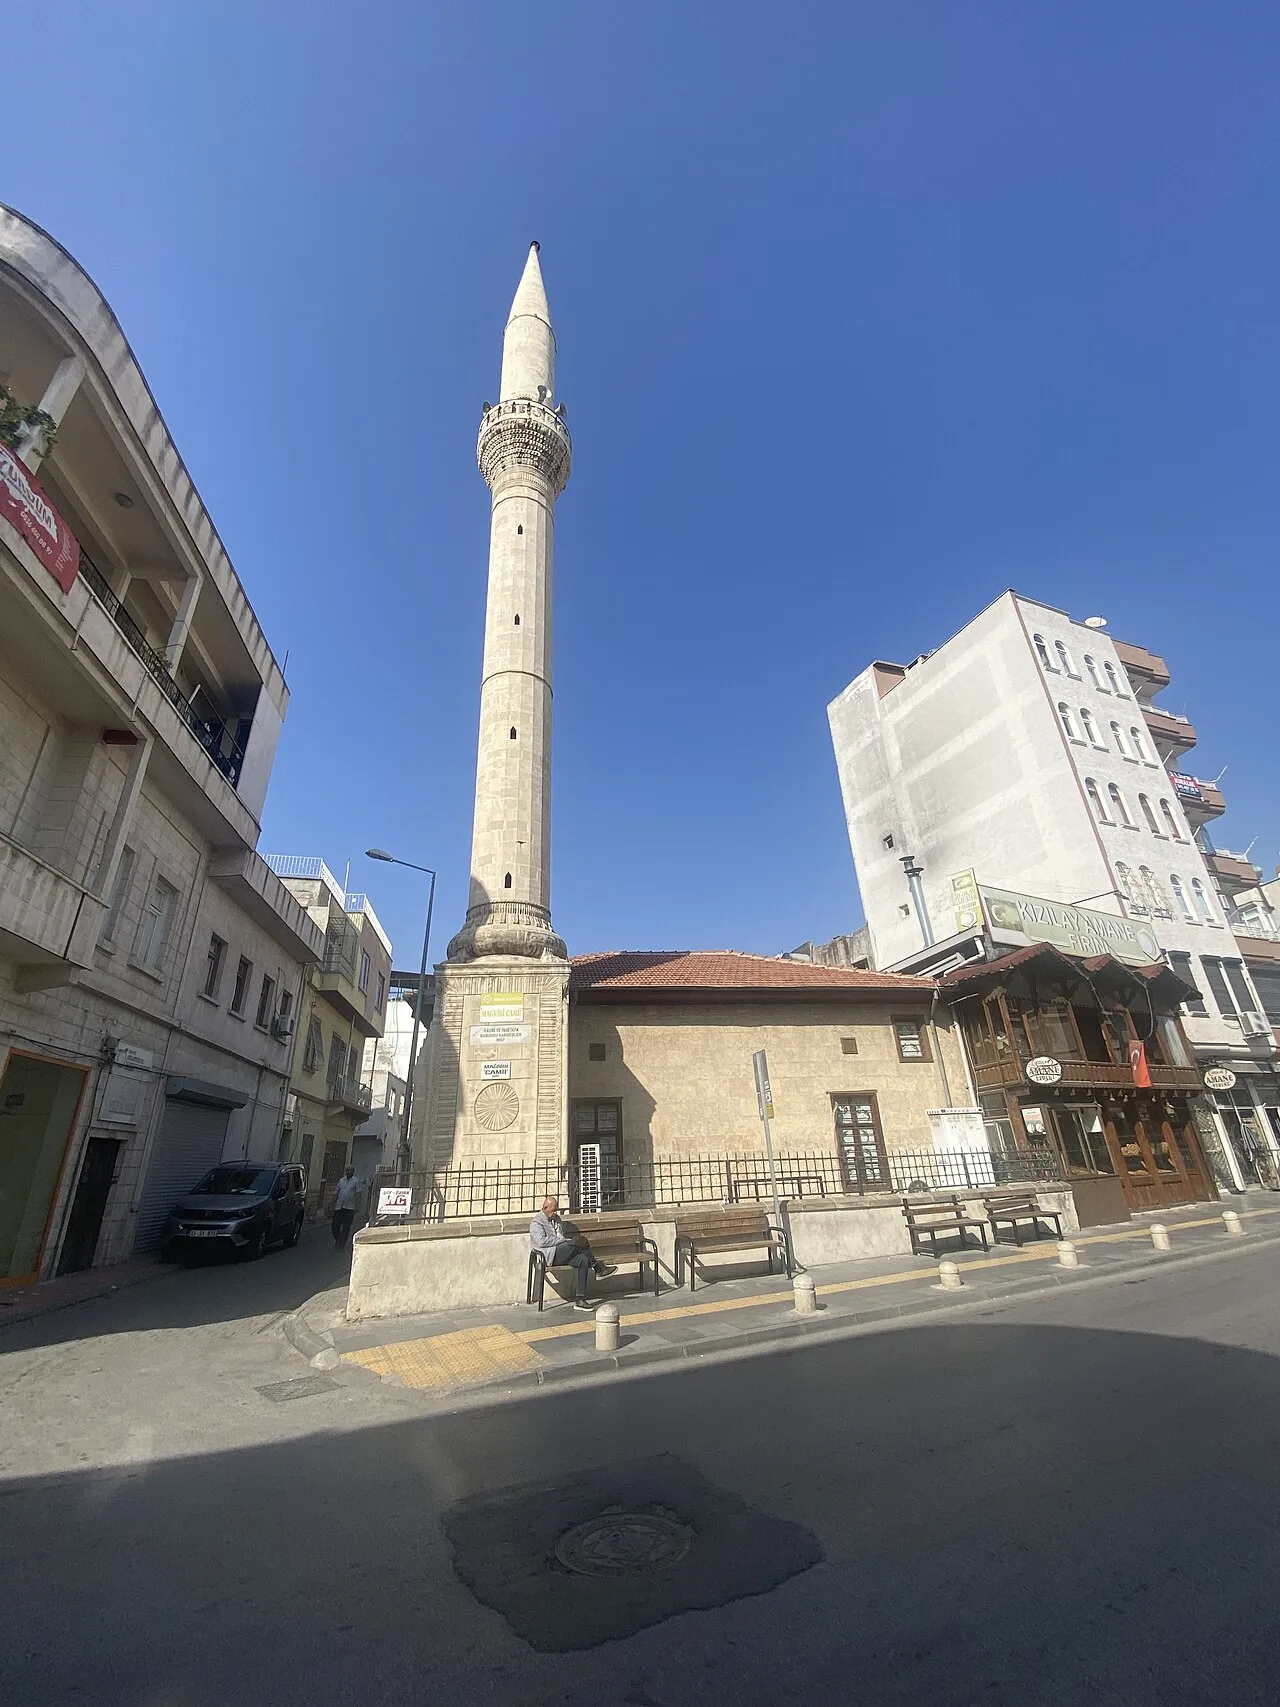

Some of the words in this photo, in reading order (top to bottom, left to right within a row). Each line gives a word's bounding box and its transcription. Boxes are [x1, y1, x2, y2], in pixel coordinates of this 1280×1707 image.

[1015, 900, 1081, 932] KIZILAY
[1084, 915, 1138, 943] AMANE
[1029, 1066, 1061, 1075] AMANE
[1206, 1074, 1234, 1084] AMANE
